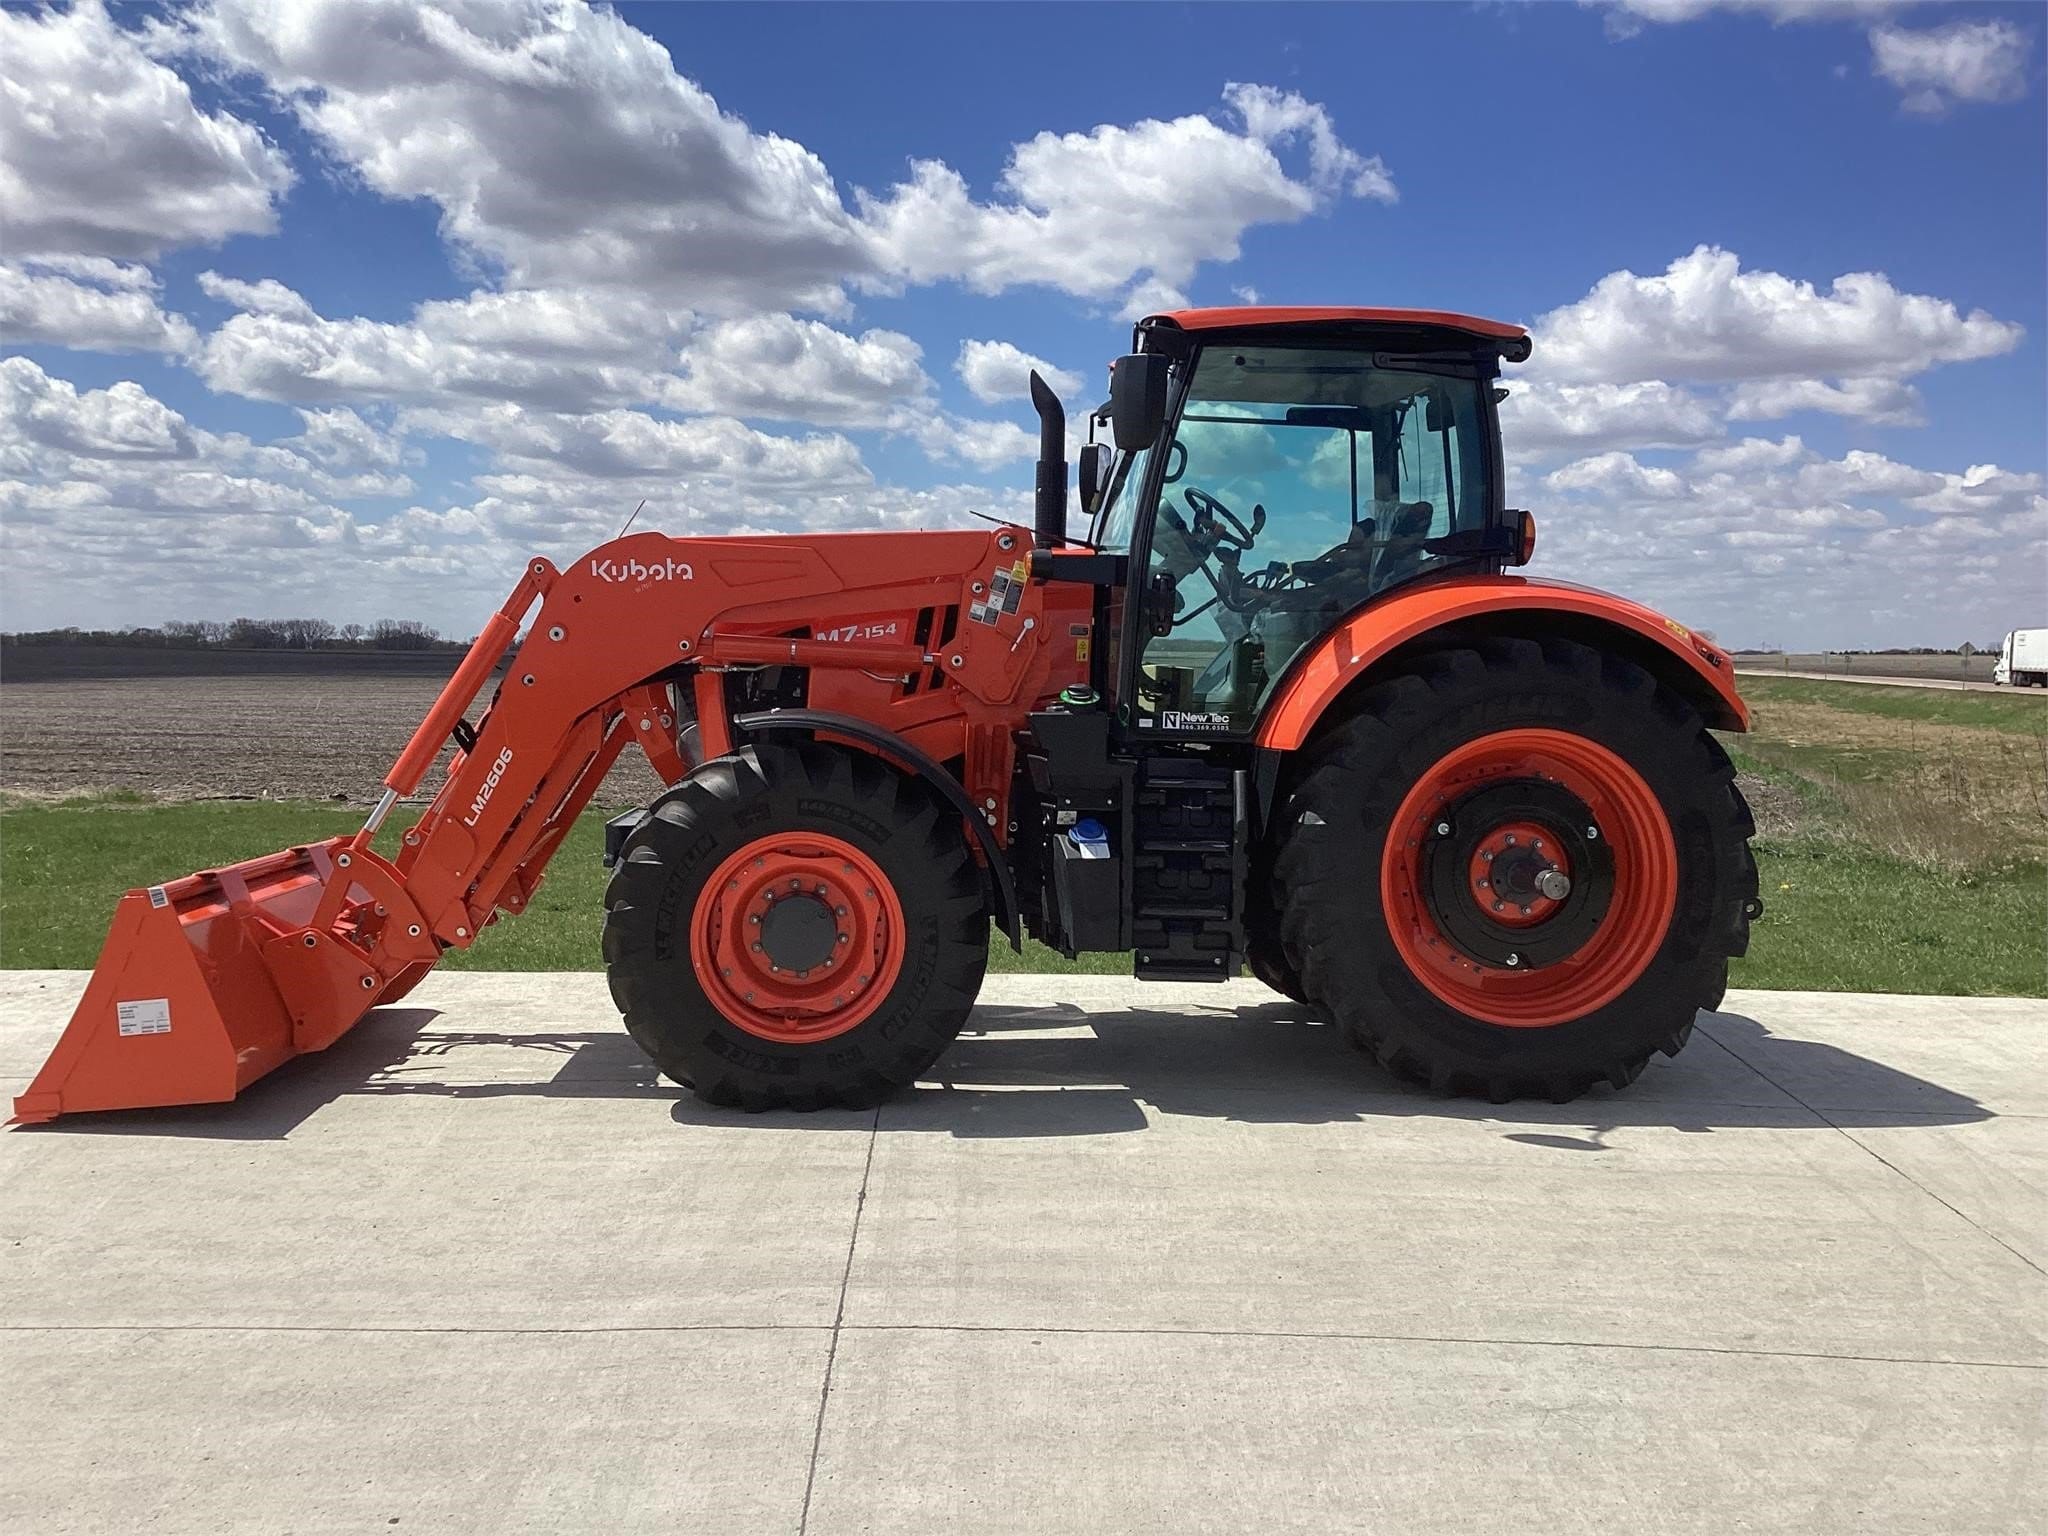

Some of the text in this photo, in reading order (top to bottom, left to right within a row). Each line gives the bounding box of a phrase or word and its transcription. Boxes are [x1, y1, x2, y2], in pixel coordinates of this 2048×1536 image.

[591, 557, 693, 582] Kubota
[1181, 712, 1230, 723] New Tec
[463, 746, 513, 827] LM2606
